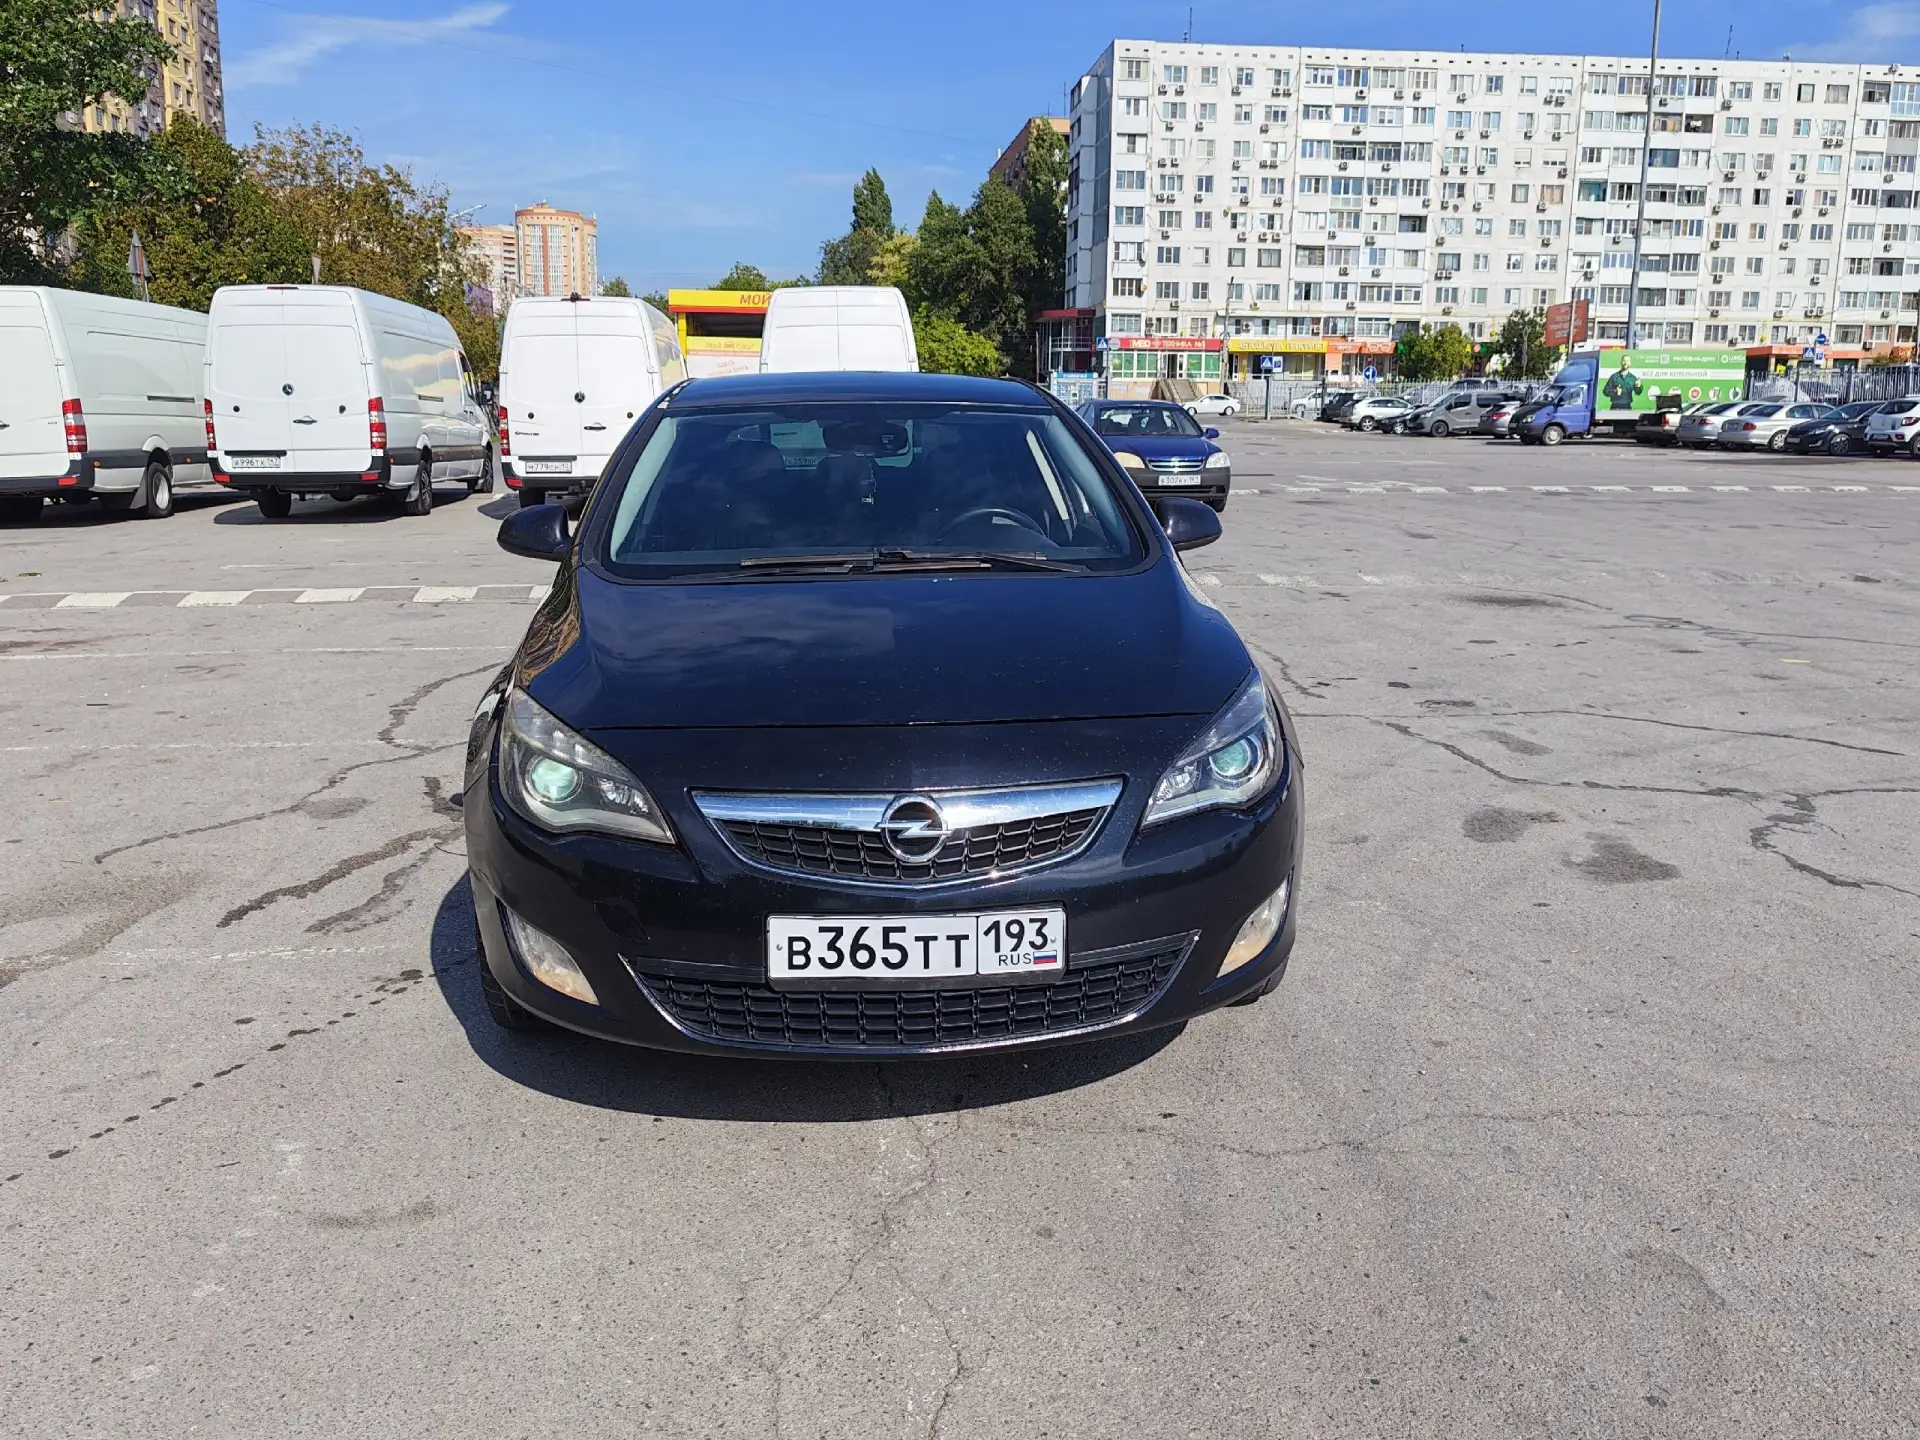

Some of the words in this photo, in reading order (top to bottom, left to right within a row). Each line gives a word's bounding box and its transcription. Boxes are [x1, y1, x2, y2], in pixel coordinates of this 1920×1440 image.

[787, 926, 969, 970] В365ТТ
[983, 917, 1049, 953] 193
[998, 952, 1032, 967] RUS
